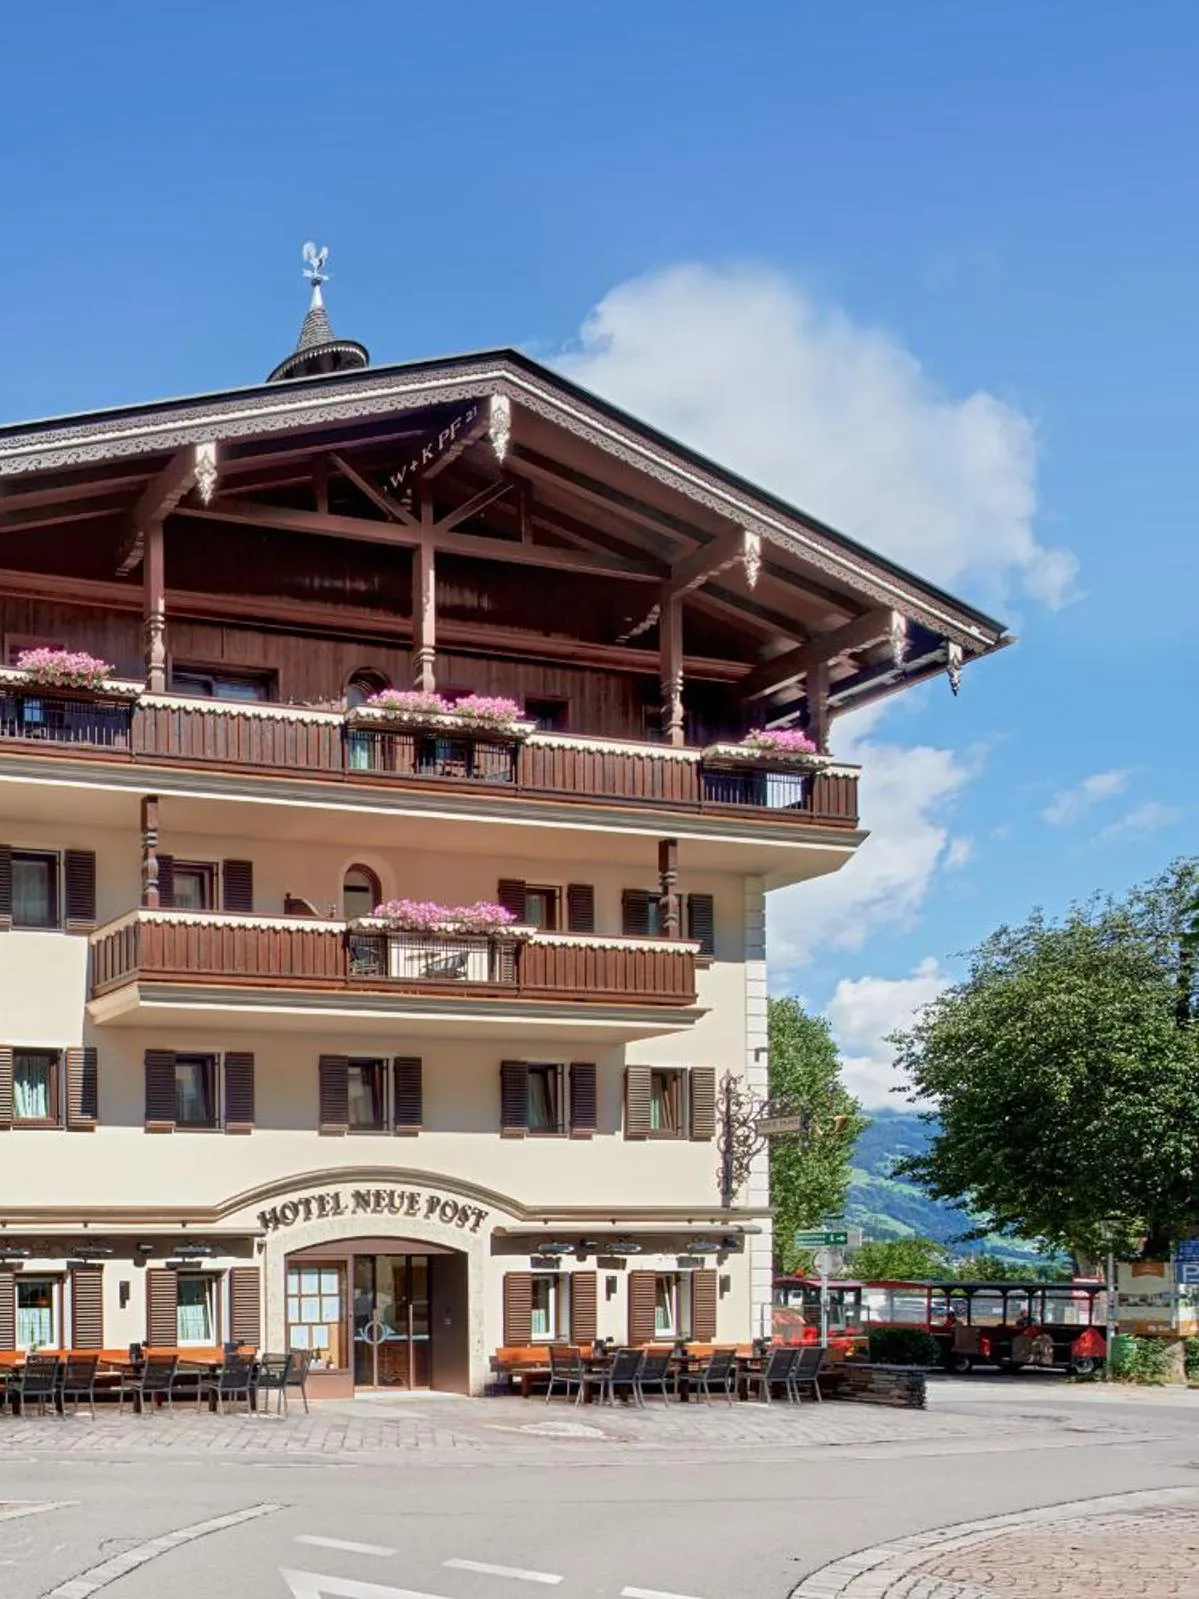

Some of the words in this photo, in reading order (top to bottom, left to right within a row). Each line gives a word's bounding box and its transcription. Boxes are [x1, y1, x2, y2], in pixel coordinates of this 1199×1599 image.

[256, 1191, 349, 1231] HOTEL
[350, 1188, 422, 1217] NEUE
[423, 1194, 489, 1233] POST
